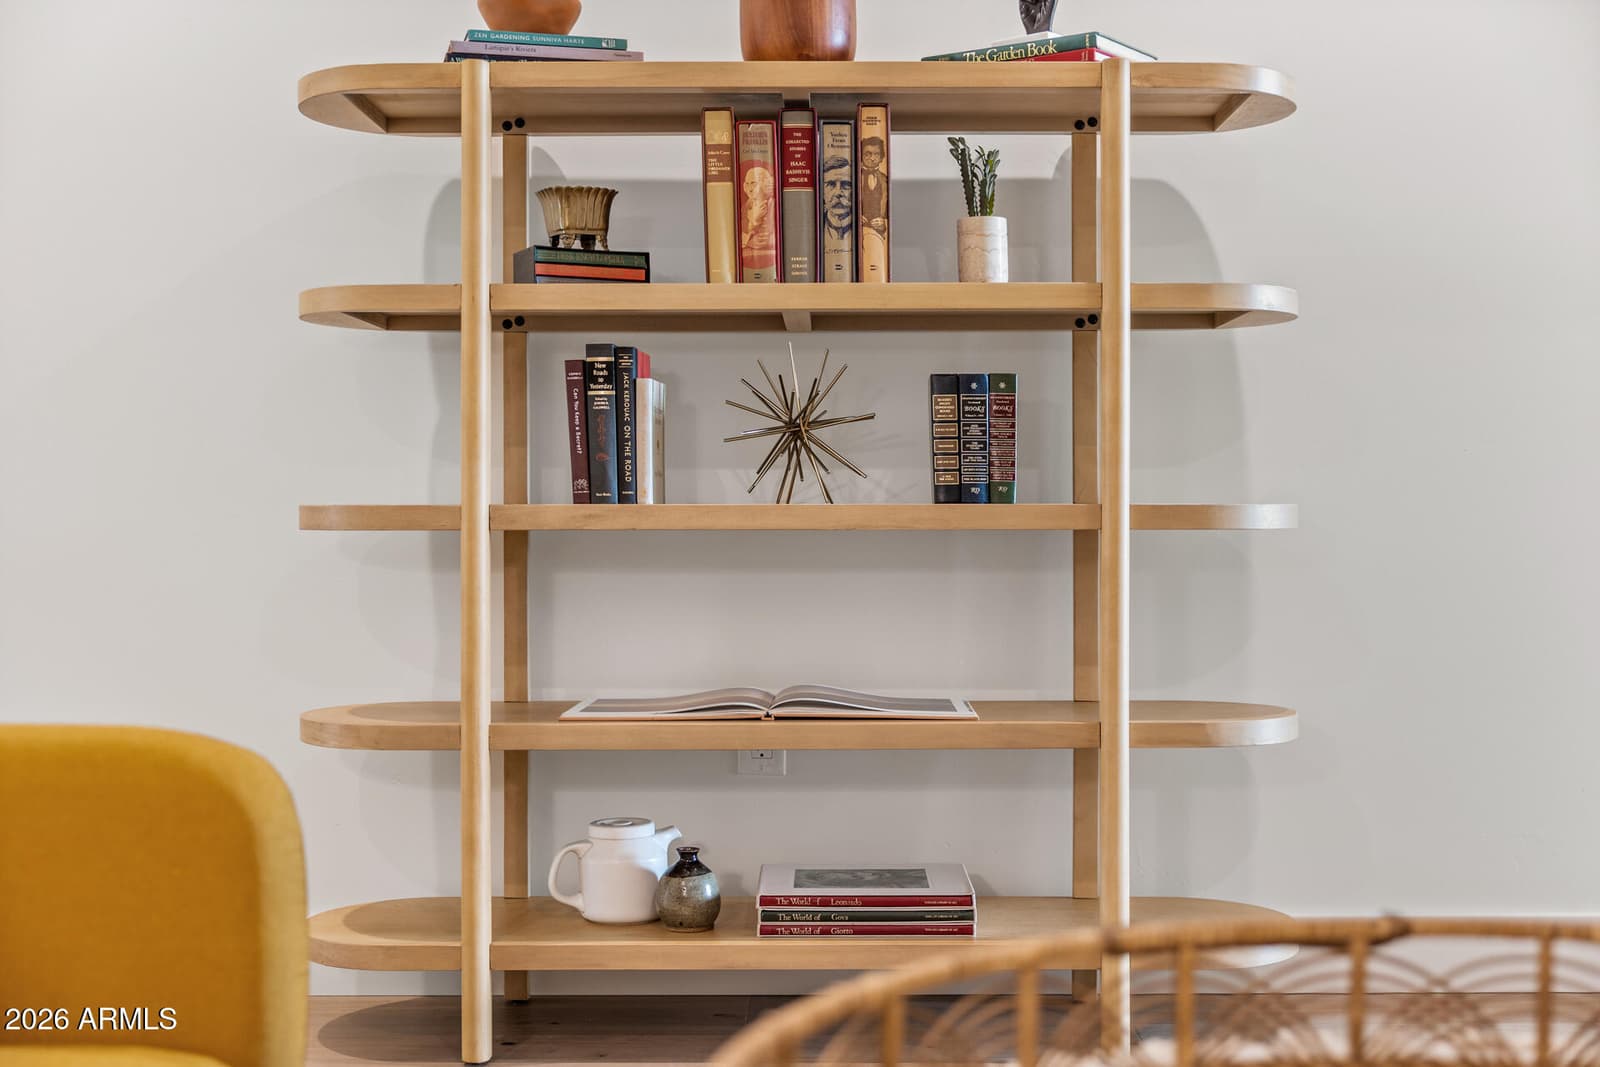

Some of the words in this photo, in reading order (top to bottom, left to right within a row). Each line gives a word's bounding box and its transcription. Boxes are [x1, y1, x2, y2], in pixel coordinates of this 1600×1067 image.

[963, 52, 984, 62] The
[986, 46, 1026, 61] Garden
[1027, 40, 1057, 56] Book
[624, 425, 631, 438] ON
[776, 897, 789, 905] The
[790, 897, 811, 905] World
[813, 927, 822, 935] of
